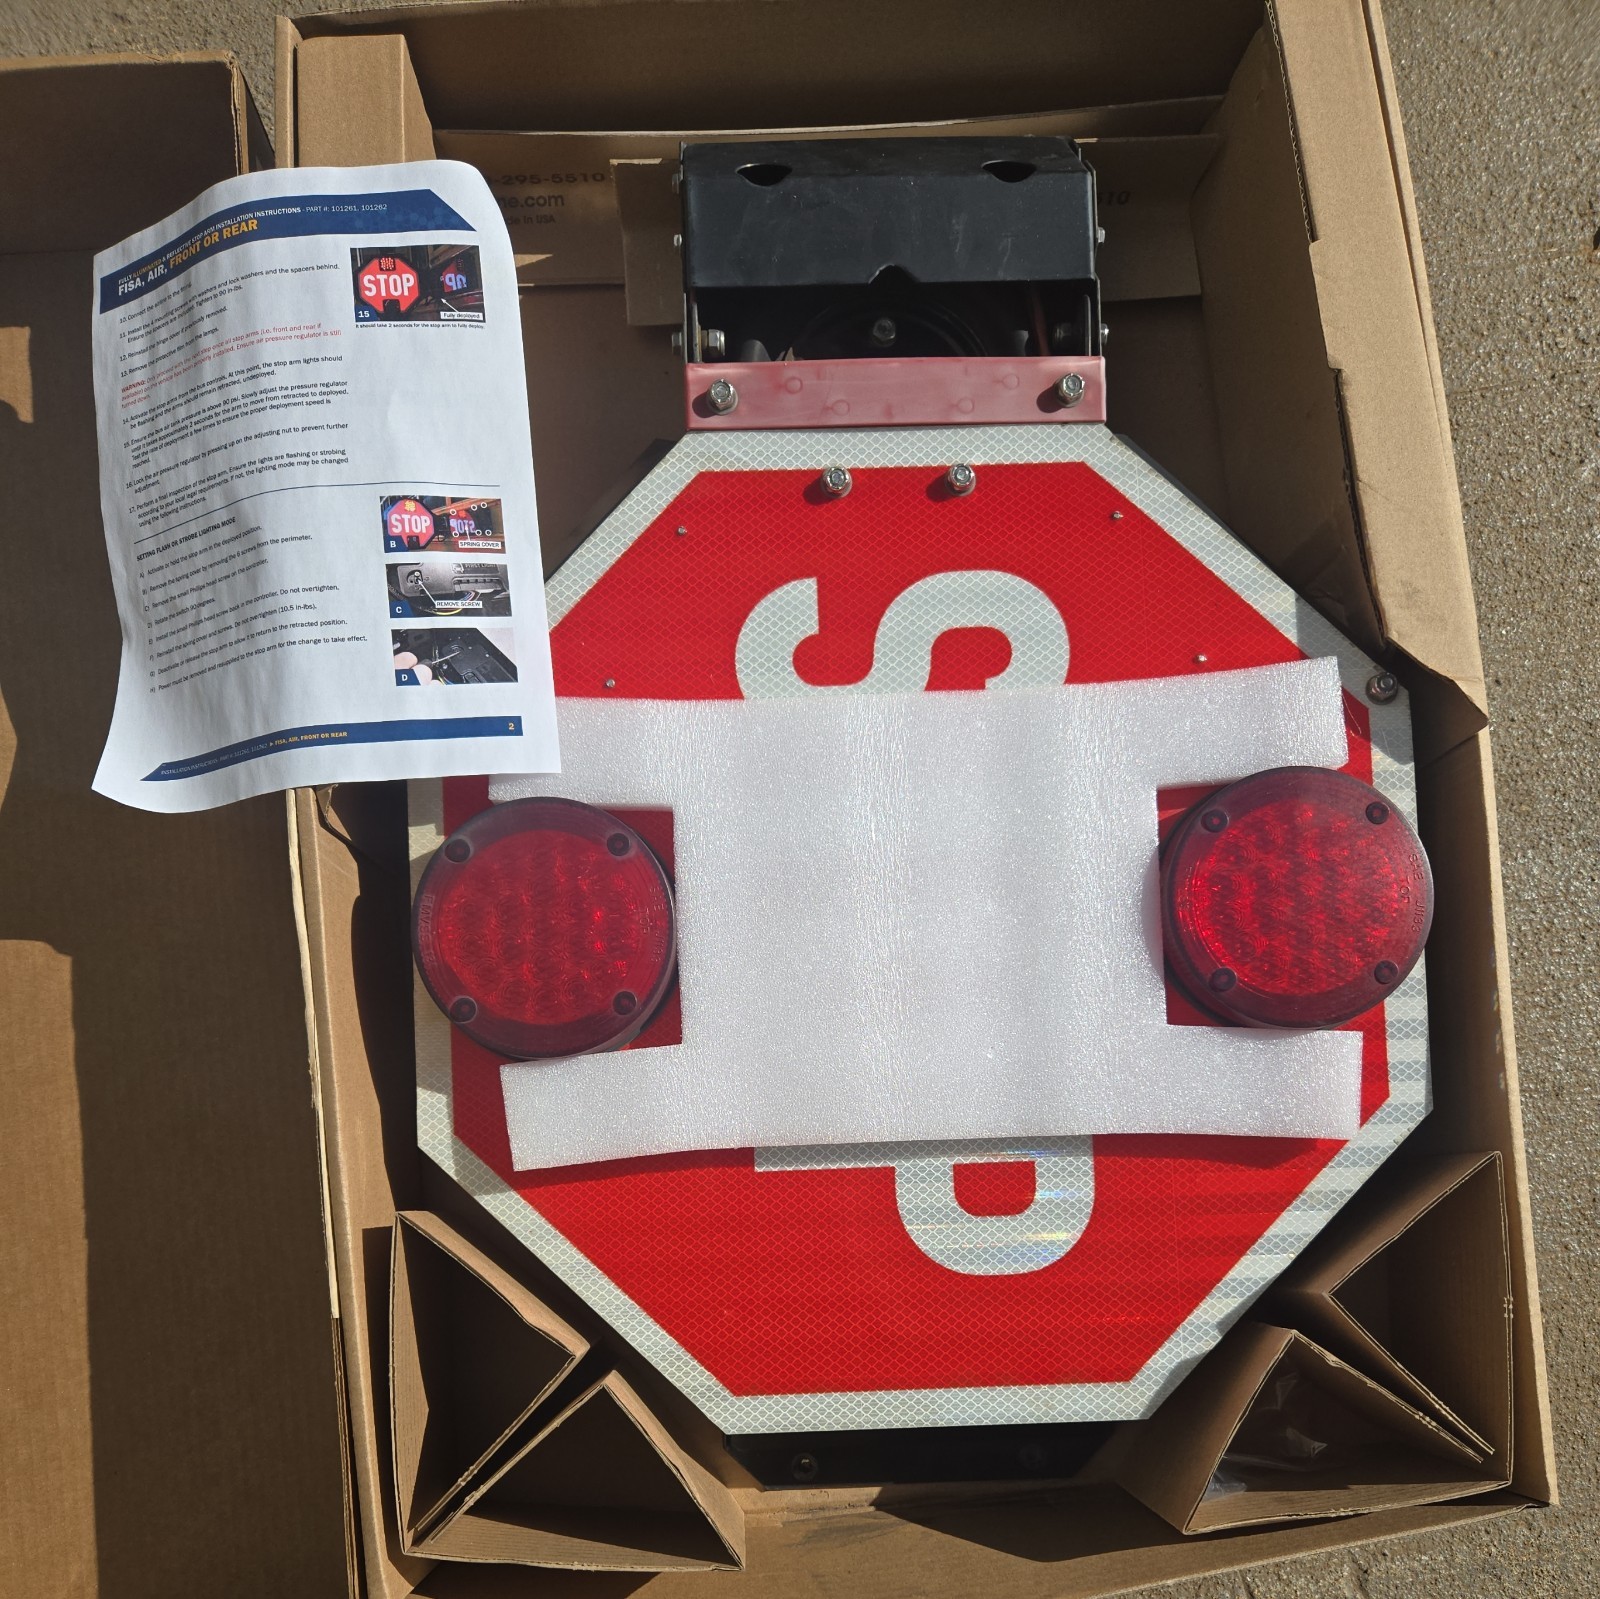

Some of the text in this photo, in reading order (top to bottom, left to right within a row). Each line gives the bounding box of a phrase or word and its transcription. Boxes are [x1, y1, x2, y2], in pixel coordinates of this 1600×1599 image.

[488, 172, 605, 186] -295-5510
[497, 194, 565, 208] ne.com
[118, 274, 132, 286] FULLY
[166, 240, 192, 260] REFLECTIVE
[191, 232, 204, 244] STOP
[203, 225, 216, 237] ARM
[215, 213, 254, 231] INSTALLATION
[254, 207, 301, 218] INSTRUCTIONS
[118, 219, 258, 296] FISA, AIR, FRONT OR REAR
[240, 271, 264, 281] washers
[290, 265, 315, 273] spacers
[363, 273, 415, 297] STOP
[265, 335, 293, 343] pressure
[294, 332, 322, 340] regulator
[234, 368, 245, 376] this
[273, 360, 288, 368] stop
[259, 386, 278, 395] adjust
[290, 382, 318, 391] pressure
[319, 380, 348, 388] regulator
[249, 398, 265, 406] move
[280, 392, 310, 400] retracted
[318, 389, 349, 397] deployed.
[240, 410, 249, 418] the
[268, 400, 304, 410] deployment
[305, 398, 325, 406] speed
[253, 428, 281, 439] adjusting
[301, 424, 326, 432] prevent
[285, 451, 311, 461] flashing
[255, 464, 277, 473] lighting
[320, 457, 349, 465] changed
[179, 532, 198, 544] STROBE
[221, 516, 236, 527] MODE
[390, 513, 431, 534] STOP
[280, 535, 313, 543] perimeter.
[390, 540, 397, 548] B
[279, 588, 289, 596] Do
[301, 584, 340, 593] overtighten.
[278, 604, 295, 614] (10.5
[395, 606, 403, 614] C
[278, 623, 289, 631] the
[289, 620, 319, 628] retracted
[320, 619, 348, 627] position.
[297, 638, 322, 646] change
[401, 673, 408, 681] D
[508, 722, 515, 730] 2
[300, 733, 320, 741] FRONT
[735, 570, 1096, 1276] SP
